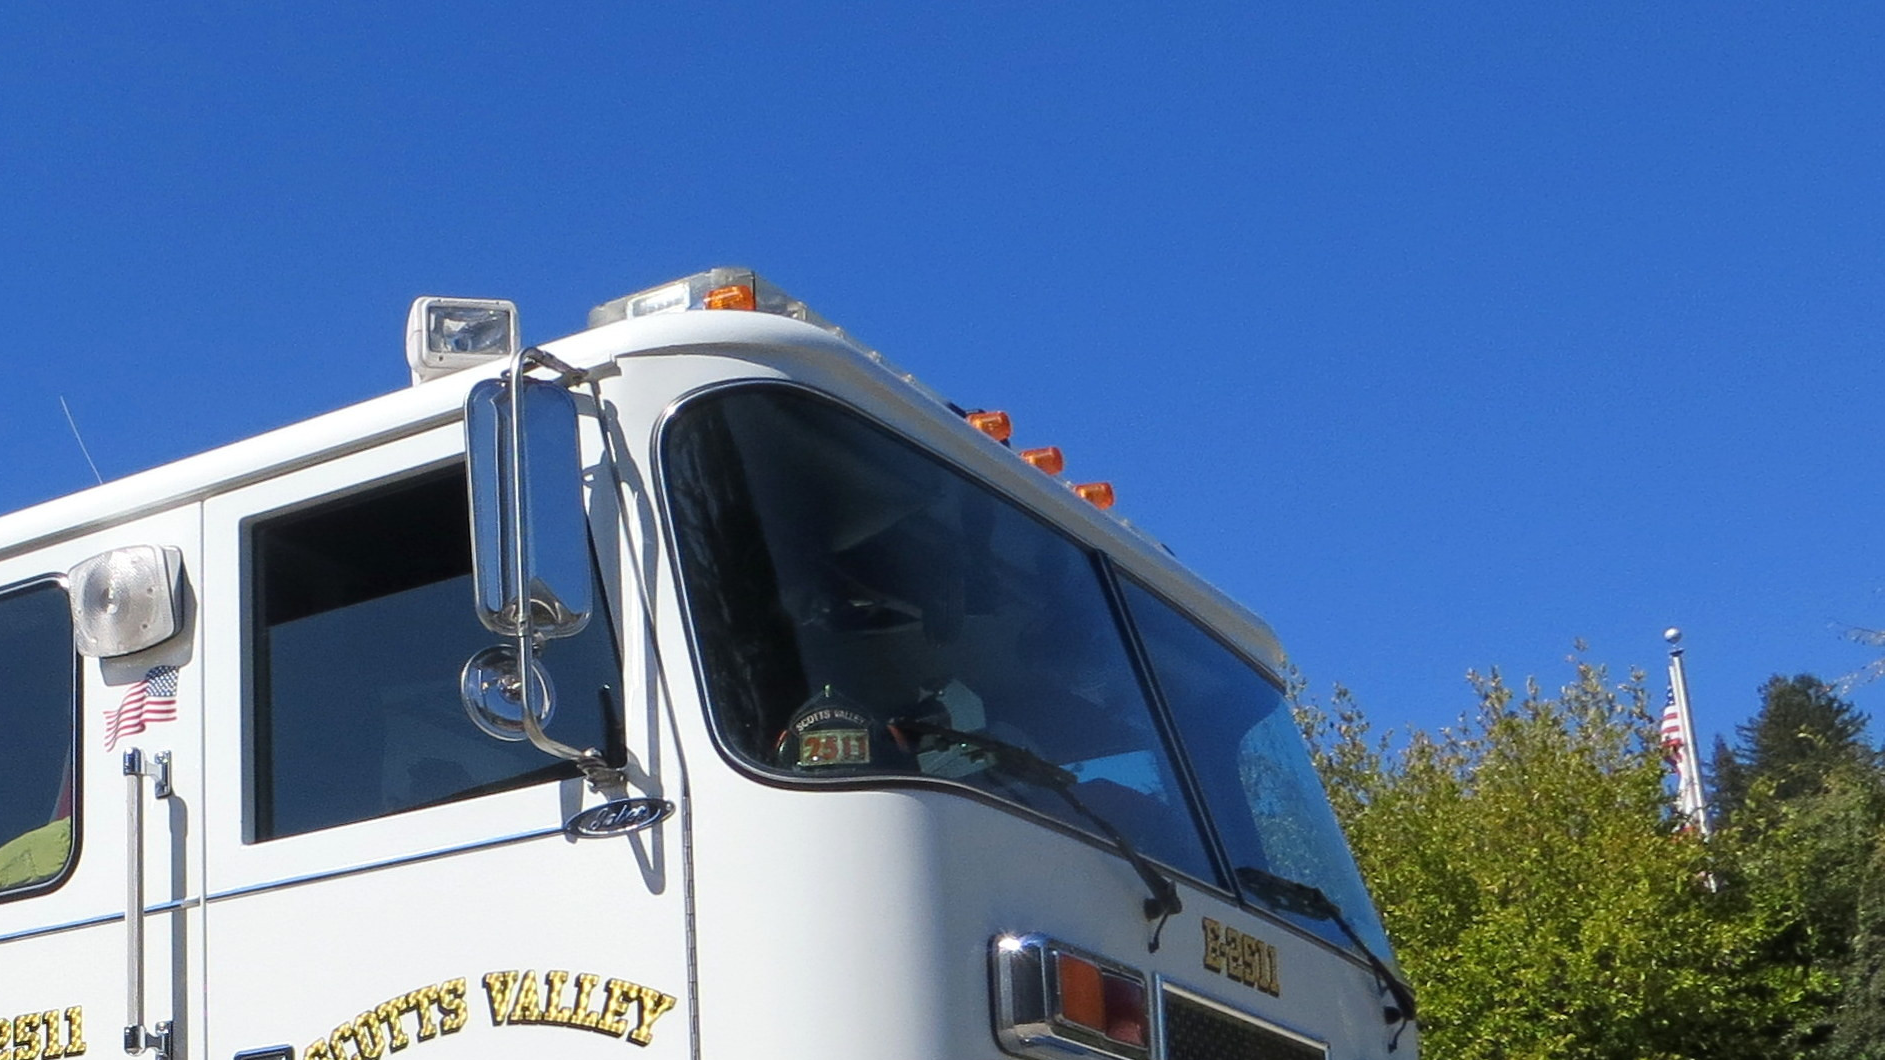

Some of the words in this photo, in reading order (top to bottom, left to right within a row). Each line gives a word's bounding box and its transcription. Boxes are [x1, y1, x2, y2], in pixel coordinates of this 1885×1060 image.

[795, 709, 831, 731] SCOTTS
[833, 708, 866, 725] VALLEY
[803, 736, 866, 761] 2511
[1201, 916, 1280, 998] E-2511
[481, 969, 678, 1048] VALLEY
